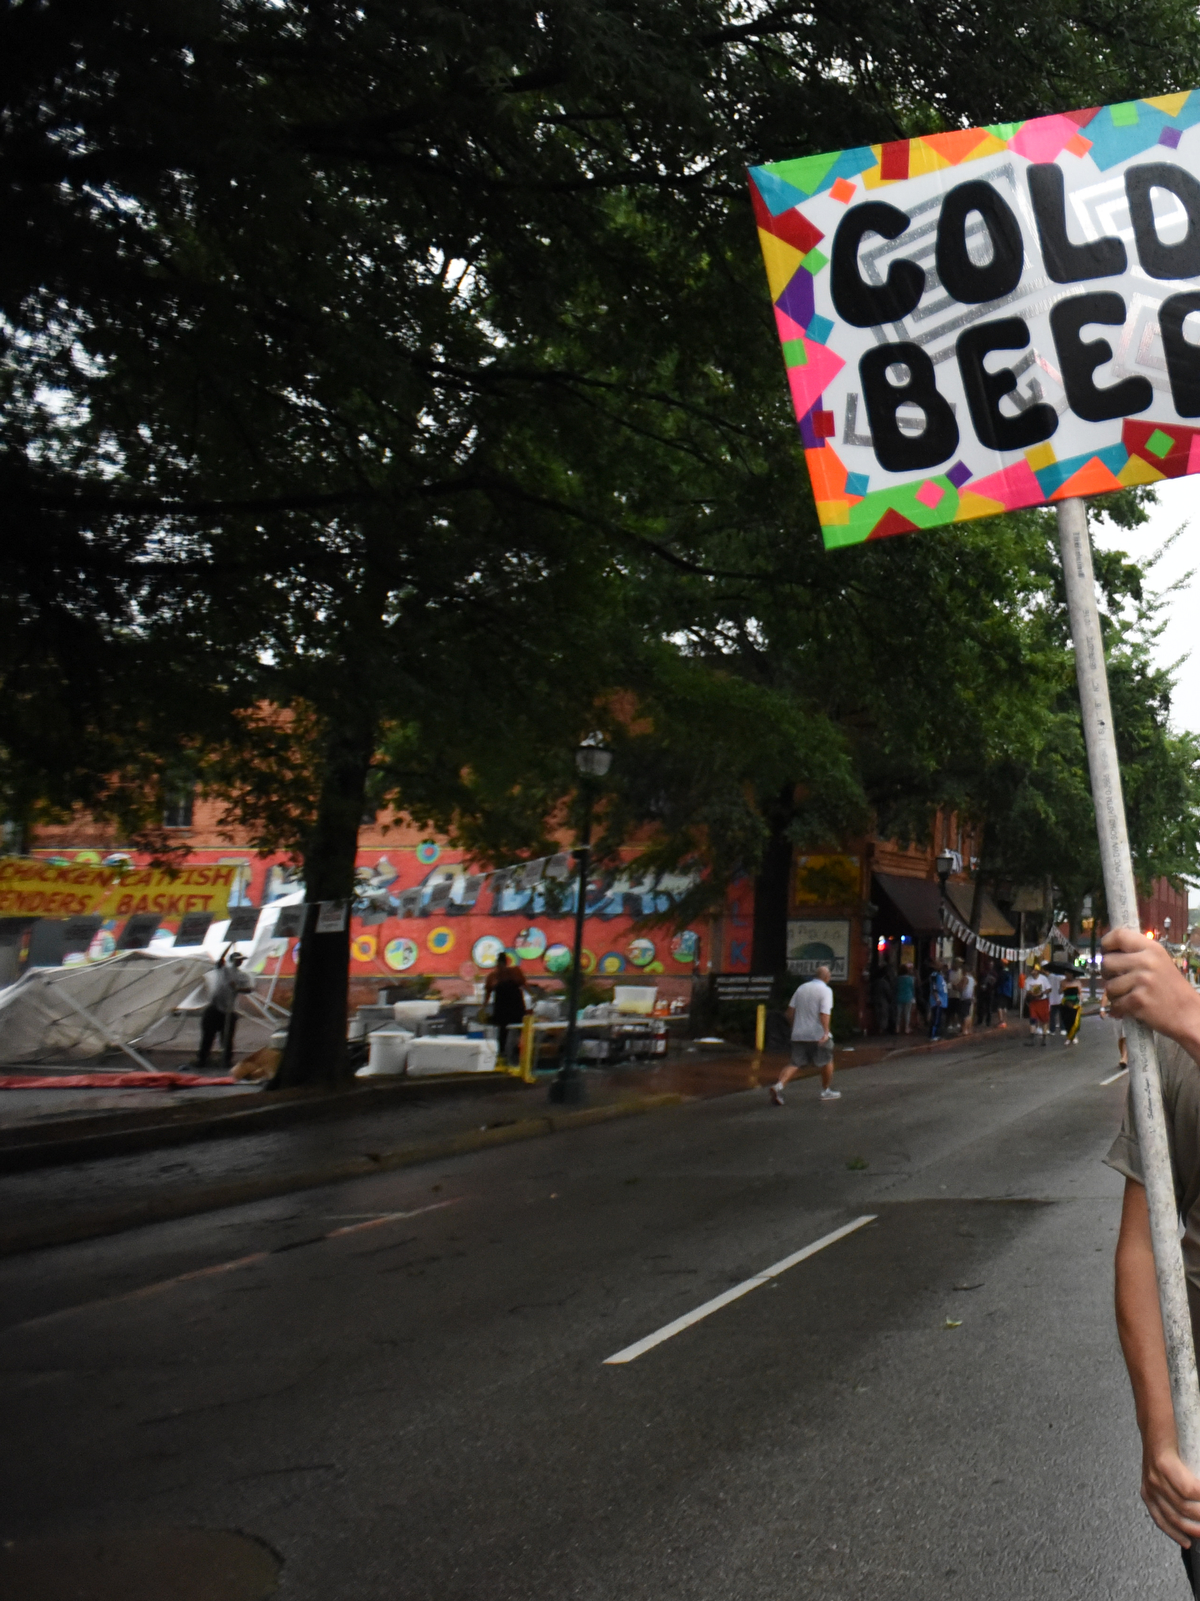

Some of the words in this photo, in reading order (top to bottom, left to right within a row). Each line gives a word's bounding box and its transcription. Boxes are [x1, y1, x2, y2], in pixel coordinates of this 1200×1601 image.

[0, 863, 115, 887] CHICKEN
[119, 867, 235, 886] CATFISH
[117, 894, 214, 915] BASKET
